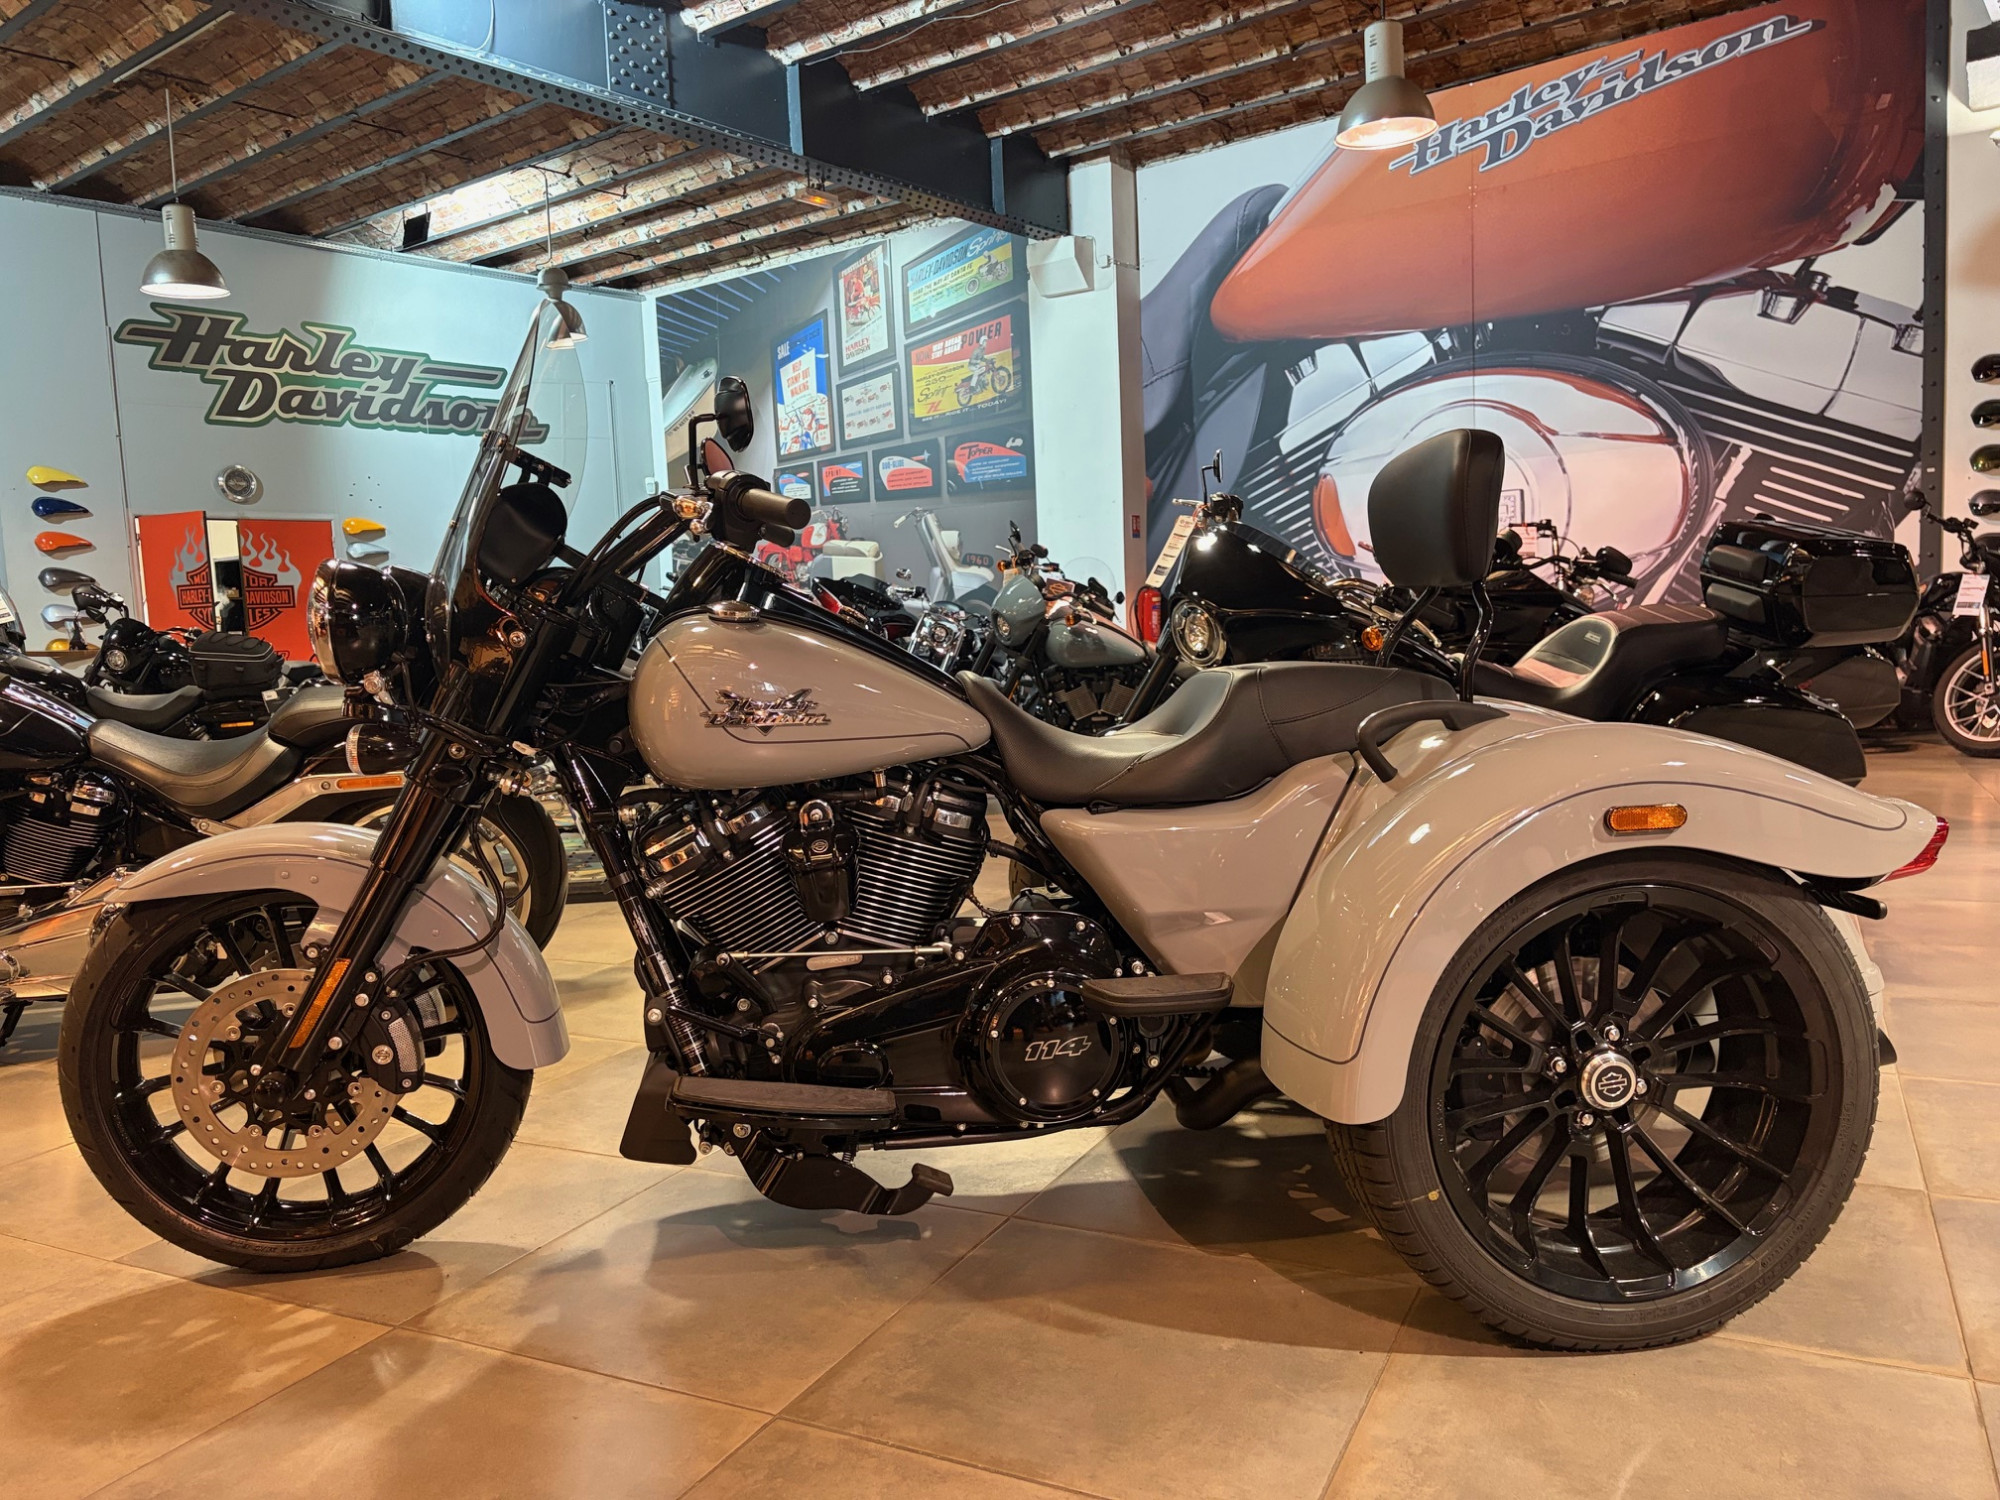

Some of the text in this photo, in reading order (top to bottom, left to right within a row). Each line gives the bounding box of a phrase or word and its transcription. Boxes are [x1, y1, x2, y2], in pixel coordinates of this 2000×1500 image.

[1457, 15, 1813, 173] Davidson
[1389, 49, 1645, 176] Harley
[115, 302, 507, 393] Harley
[845, 336, 870, 353] HARLEY
[961, 320, 1002, 349] POWER
[845, 344, 871, 360] DAVIDSON
[205, 368, 551, 445] Davidson
[917, 386, 953, 404] Sprint
[976, 398, 1007, 410] TODAY!
[966, 554, 989, 566] 1960
[1025, 1035, 1092, 1062] 114
